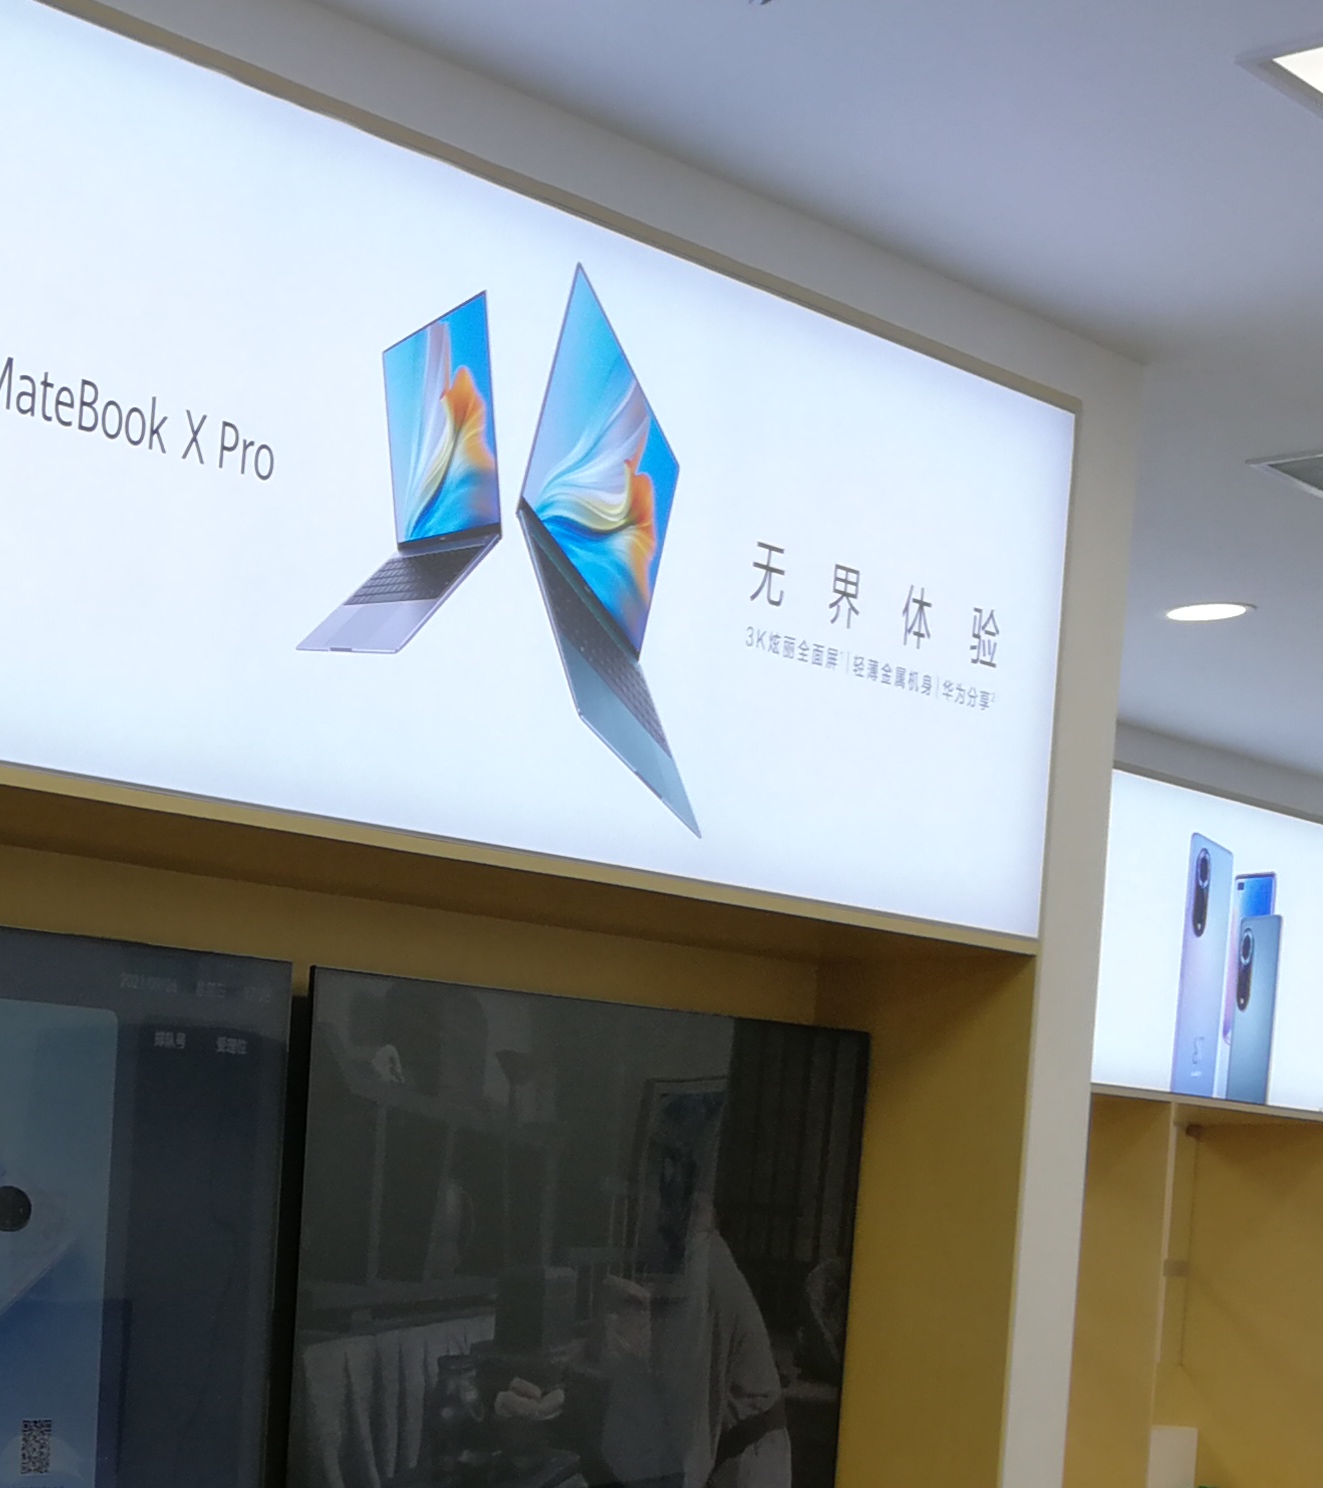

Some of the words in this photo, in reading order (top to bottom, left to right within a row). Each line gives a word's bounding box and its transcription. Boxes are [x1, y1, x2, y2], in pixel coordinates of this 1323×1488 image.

[181, 409, 208, 465] X
[218, 420, 275, 481] Pro
[750, 541, 1000, 668] 无界体验
[852, 654, 933, 697] 轻薄金属机身
